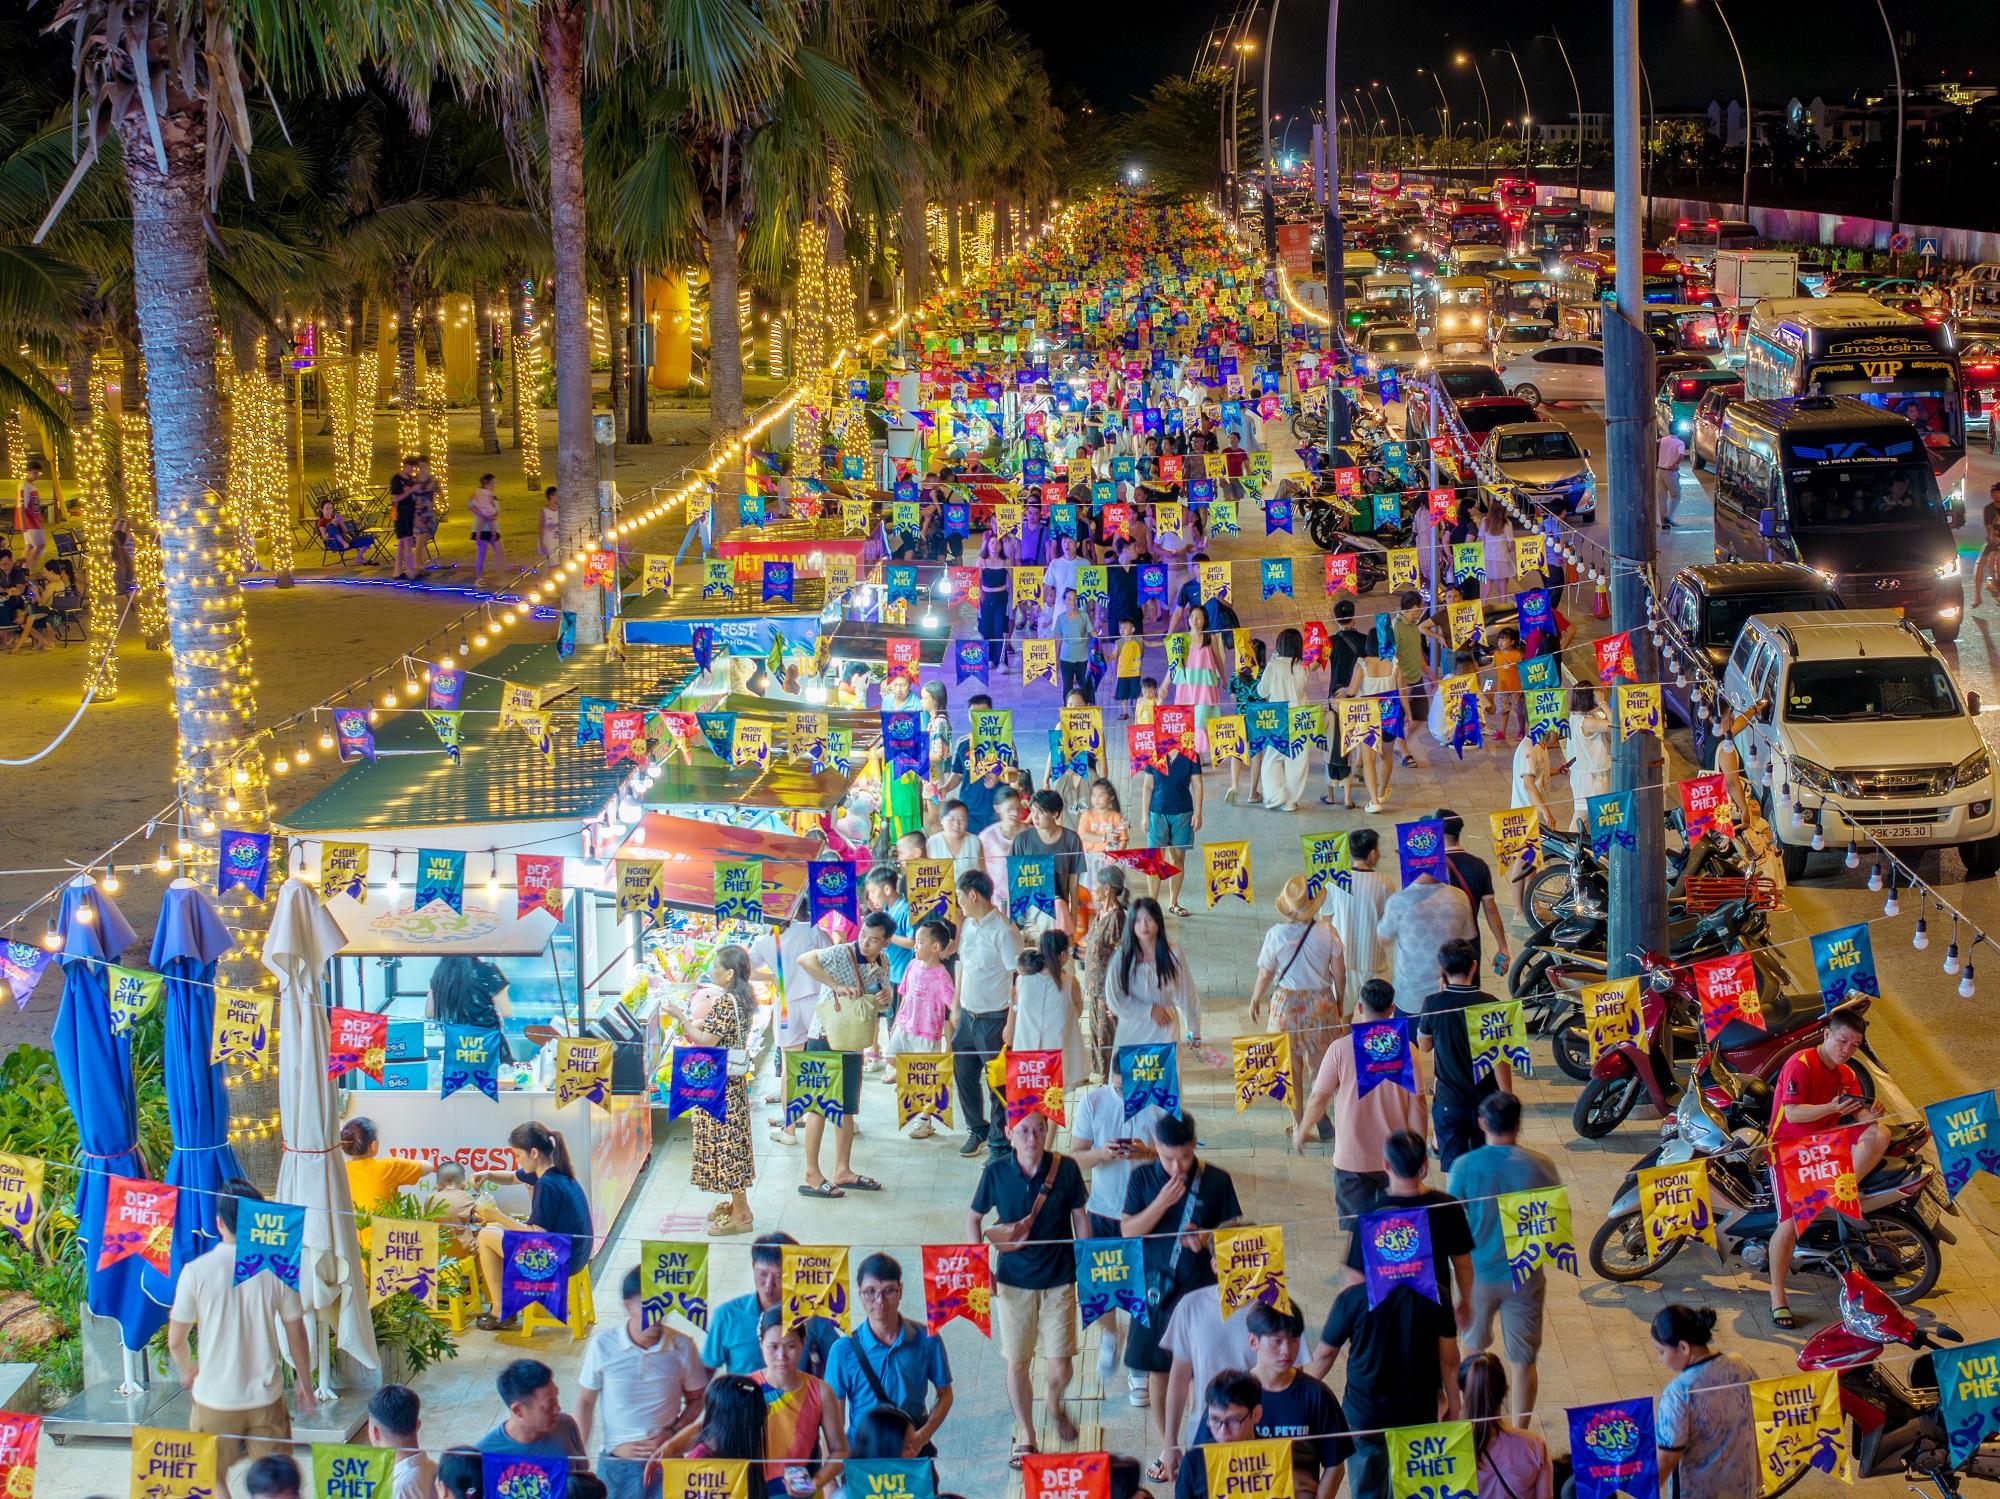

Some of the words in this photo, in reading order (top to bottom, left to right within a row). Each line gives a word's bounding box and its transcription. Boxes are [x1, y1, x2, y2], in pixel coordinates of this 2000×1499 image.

[1829, 343, 1934, 354] Limousine
[1860, 361, 1904, 378] VIP
[1502, 814, 1526, 828] CHILL
[1870, 826, 1926, 838] 29K-235.30
[332, 846, 356, 859] CHILL
[1214, 849, 1238, 859] NGON
[1314, 839, 1334, 853] SAY
[626, 867, 651, 876] NGON
[726, 868, 747, 880] SAY
[917, 866, 941, 877] CHILL
[1828, 938, 1856, 955] VUI
[118, 976, 144, 992] SAY
[1595, 990, 1625, 1003] NGON
[229, 999, 258, 1011] NGON
[1481, 1011, 1507, 1027] SAY
[459, 1035, 485, 1050] VUI
[1247, 1043, 1274, 1058] CHILL
[569, 1045, 598, 1060] CHILL
[800, 1060, 825, 1075] SAY
[908, 1062, 937, 1072] NGON
[1134, 1055, 1161, 1069] VUI
[1944, 1108, 1979, 1130] VUI
[0, 1164, 24, 1177] GON
[1654, 1172, 1690, 1189] NGON
[1518, 1200, 1548, 1220] SAY
[254, 1213, 284, 1230] VUI
[389, 1229, 421, 1245] CHILL
[1233, 1236, 1268, 1253] CHILL
[658, 1252, 688, 1269] SAY
[798, 1257, 831, 1268] NGON
[1093, 1248, 1123, 1266] VUI
[1958, 1358, 2000, 1380] VUI
[1774, 1388, 1816, 1408] CHILL
[154, 1442, 196, 1459] CHILL
[1410, 1436, 1446, 1458] SAY
[333, 1458, 369, 1479] SAY
[1228, 1452, 1271, 1474] CHILL
[688, 1472, 730, 1488] CHILL
[868, 1472, 906, 1493] VUI
